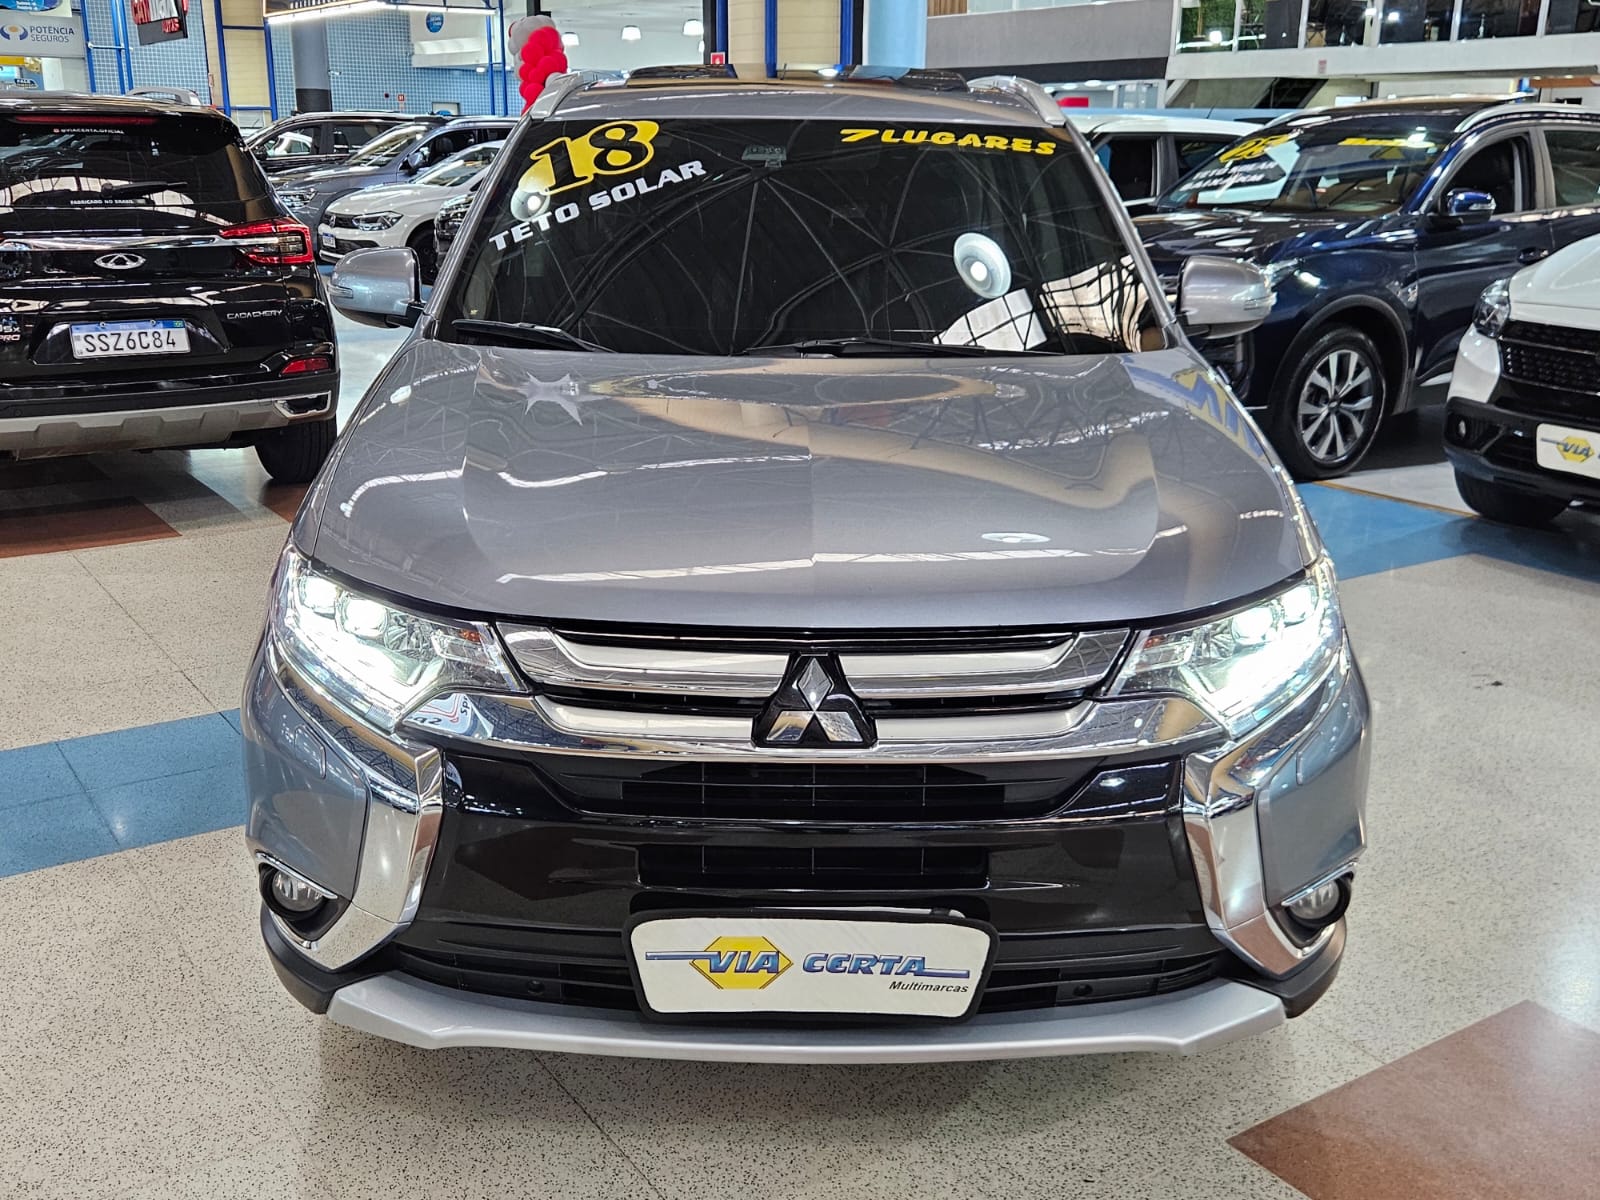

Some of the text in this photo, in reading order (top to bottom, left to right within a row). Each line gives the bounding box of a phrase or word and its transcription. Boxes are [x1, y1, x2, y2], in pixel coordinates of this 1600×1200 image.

[30, 26, 75, 35] POTENCIA
[31, 35, 69, 43] SEGUROS
[840, 128, 1057, 155] 7 LUGARES
[523, 120, 659, 195] 18
[489, 160, 707, 251] TETO SOLAR
[84, 330, 176, 353] SSZ6C84
[1558, 441, 1592, 457] VIA
[702, 950, 928, 977] VIA CERTA
[889, 980, 969, 994] Multimarcas
